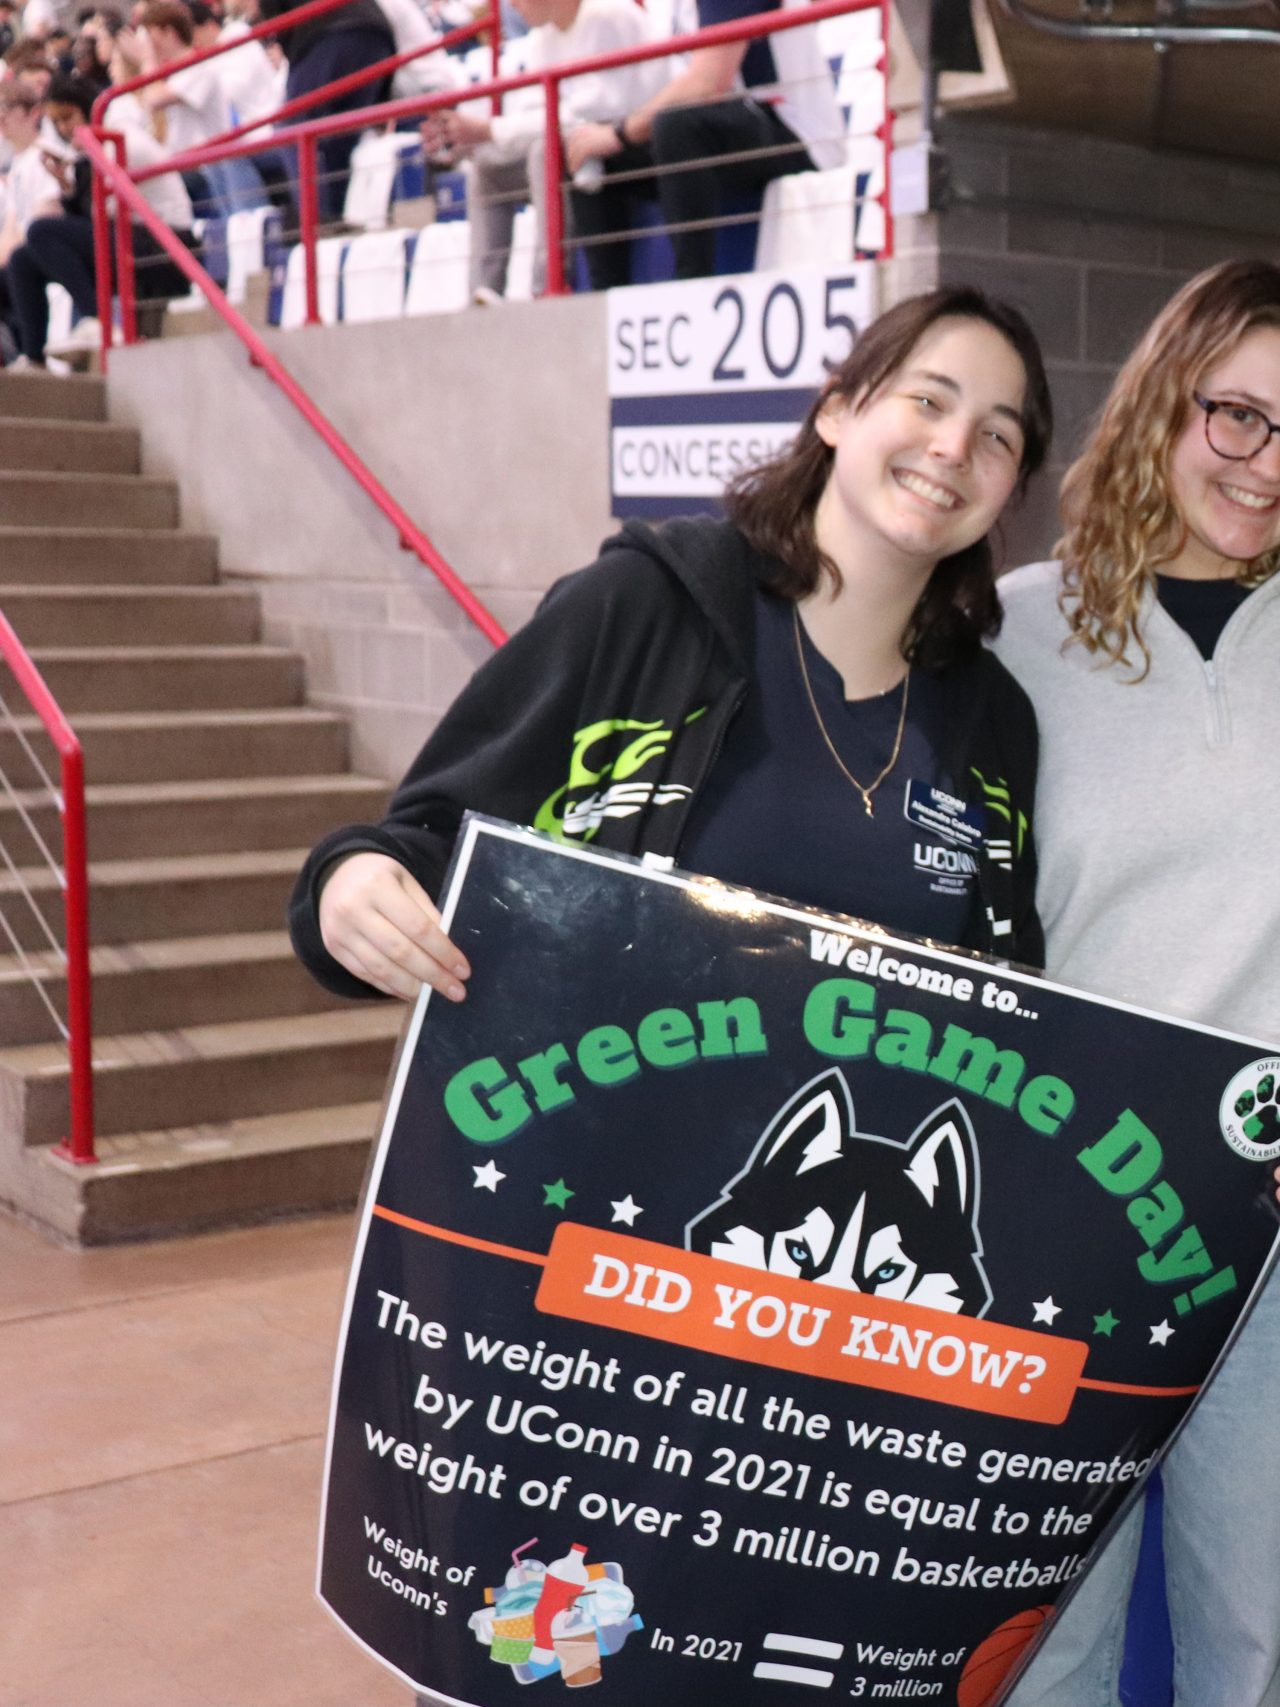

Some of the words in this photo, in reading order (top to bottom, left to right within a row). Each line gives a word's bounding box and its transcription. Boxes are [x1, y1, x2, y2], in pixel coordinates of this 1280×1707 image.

[617, 314, 691, 371] SEC
[712, 277, 858, 381] 205
[619, 440, 793, 478] CONCESSI
[914, 843, 978, 873] UCONN
[809, 929, 974, 1002] Welcome
[981, 980, 1038, 1020] to...
[444, 996, 768, 1144] Green
[803, 977, 1076, 1137] Game
[1077, 1107, 1238, 1316] Day!
[584, 1253, 692, 1313] DID
[714, 1284, 831, 1347] YOU
[841, 1315, 1047, 1394] KNOW?
[377, 1290, 447, 1349] The
[464, 1331, 620, 1392] weight
[633, 1372, 685, 1406] of
[690, 1384, 748, 1424] all
[762, 1397, 831, 1440] the
[847, 1420, 967, 1467] waste
[977, 1449, 1159, 1484] generated
[414, 1374, 473, 1430] by
[486, 1394, 640, 1464] UConn
[653, 1436, 693, 1477] in
[705, 1447, 811, 1500] 2021
[820, 1471, 852, 1508] is
[864, 1488, 980, 1530] equal
[992, 1504, 1030, 1536] to
[1040, 1505, 1093, 1536] the
[364, 1422, 507, 1499] weight
[519, 1475, 572, 1511] of
[578, 1493, 682, 1538] over
[693, 1510, 722, 1547] 3
[733, 1527, 880, 1577] million
[892, 1548, 1088, 1590] basketballs
[363, 1516, 440, 1577] Weight
[446, 1565, 476, 1587] of
[367, 1555, 448, 1616] Uconn's
[650, 1628, 674, 1653] In
[682, 1634, 743, 1662] 2021
[855, 1642, 938, 1671] Weight
[942, 1647, 965, 1666] of
[850, 1677, 866, 1697] 3
[872, 1678, 942, 1698] million
